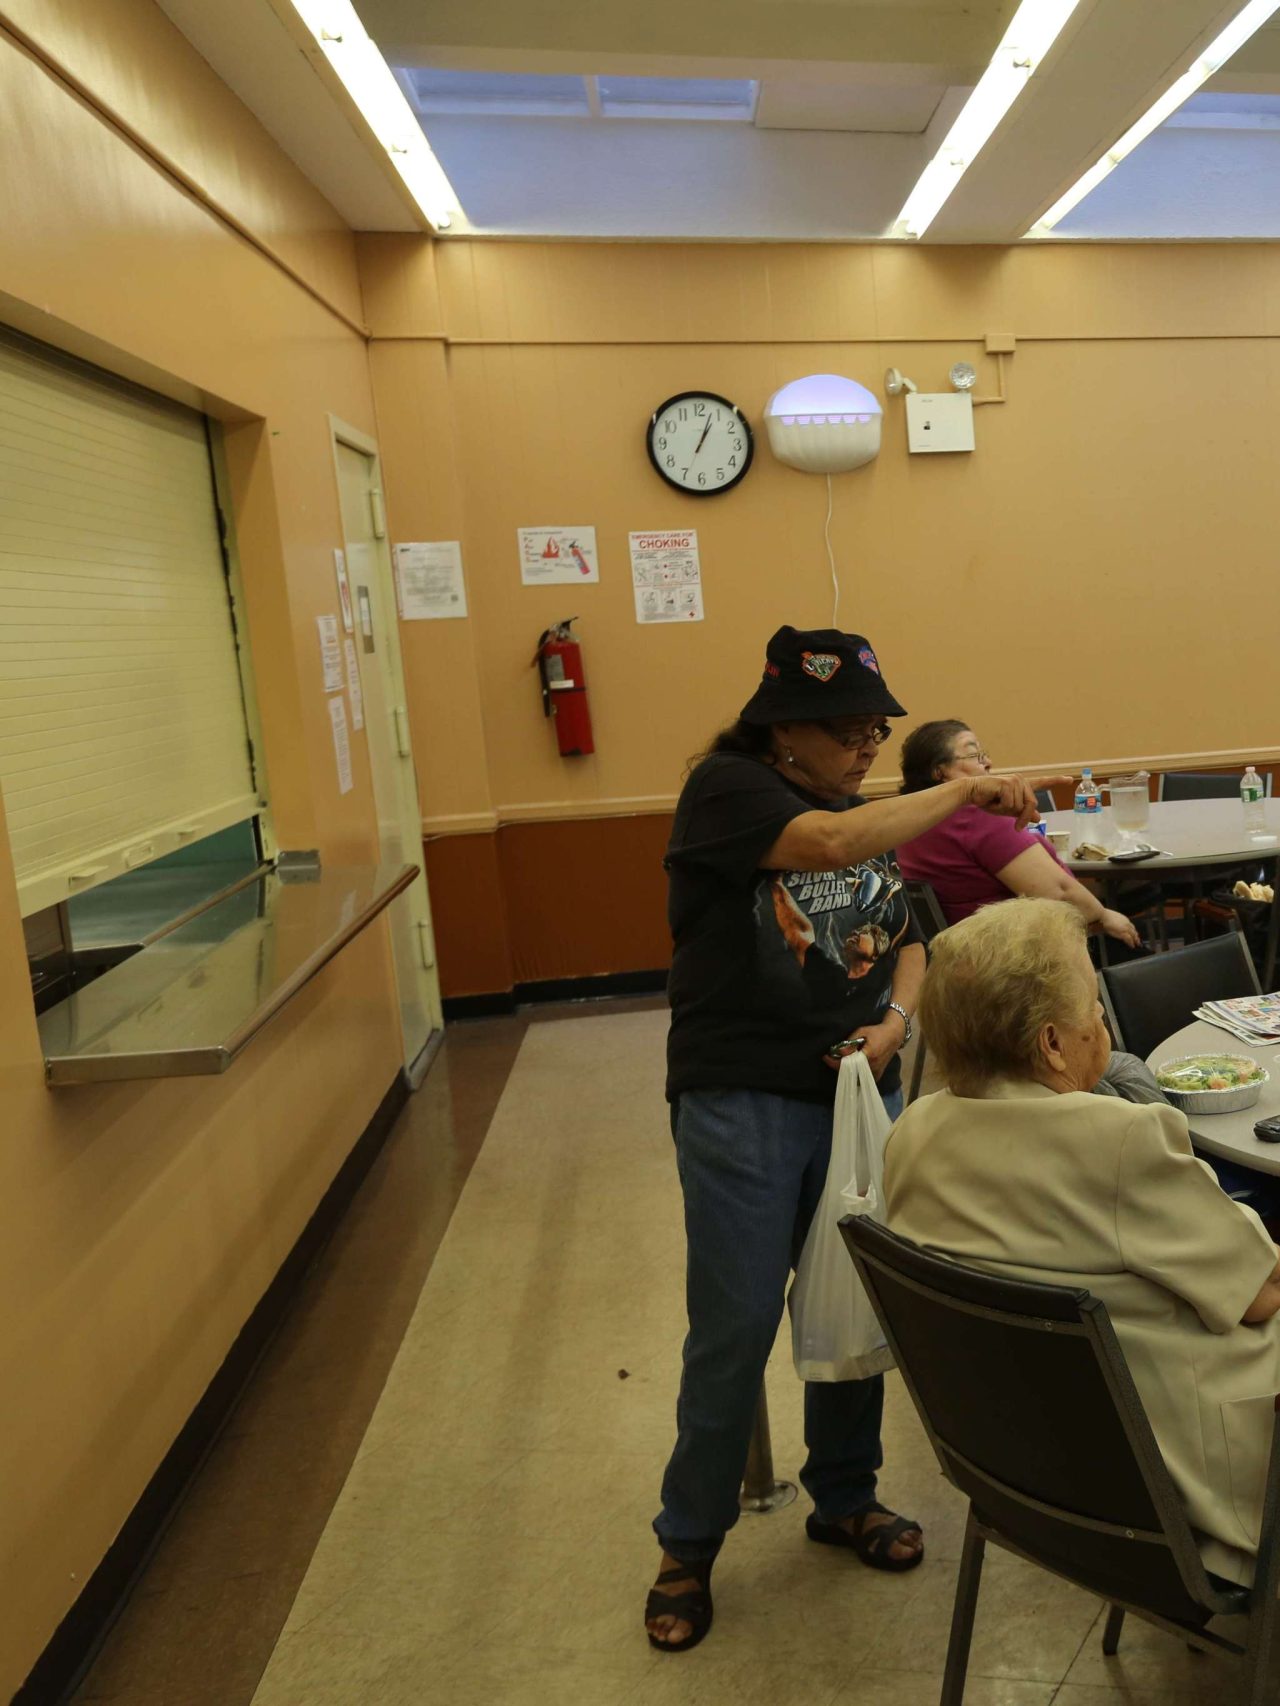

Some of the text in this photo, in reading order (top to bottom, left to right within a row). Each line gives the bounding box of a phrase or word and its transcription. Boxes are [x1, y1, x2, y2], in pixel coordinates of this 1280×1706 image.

[679, 408, 687, 421] 11
[694, 403, 705, 417] 12
[664, 420, 677, 433] 10
[727, 421, 735, 434] 2
[658, 437, 667, 450] 9
[733, 438, 742, 451] 3
[666, 455, 675, 468] 8
[728, 455, 736, 468] 4
[681, 468, 689, 480] 7
[697, 472, 706, 485] 6
[716, 468, 725, 480] 5
[639, 538, 690, 549] CHOKING
[787, 871, 836, 887] SILVER
[798, 881, 846, 901] BULLET
[808, 894, 852, 914] BAND
